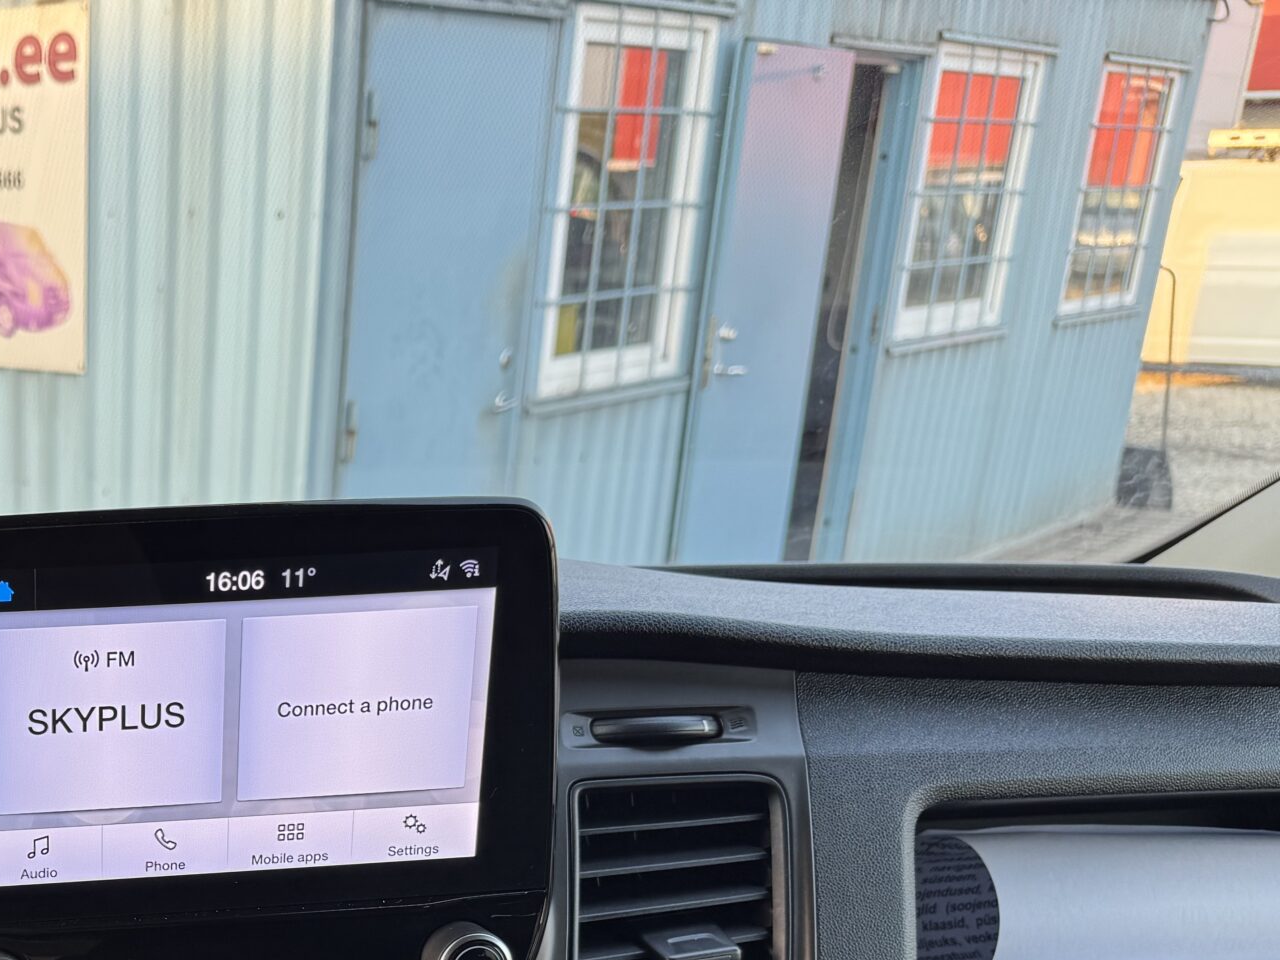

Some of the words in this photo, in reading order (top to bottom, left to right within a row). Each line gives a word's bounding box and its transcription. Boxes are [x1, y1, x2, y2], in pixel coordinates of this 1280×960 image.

[206, 570, 265, 594] 16:06
[281, 568, 317, 590] 11°
[106, 650, 136, 669] FM
[277, 699, 357, 719] Connect
[360, 700, 372, 716] a
[376, 694, 434, 716] phone
[27, 701, 186, 737] SKYPLUS
[251, 851, 294, 867] Mobile
[297, 851, 329, 866] apps
[388, 843, 439, 860] Settings
[20, 866, 58, 881] Audio
[145, 858, 186, 873] Phone
